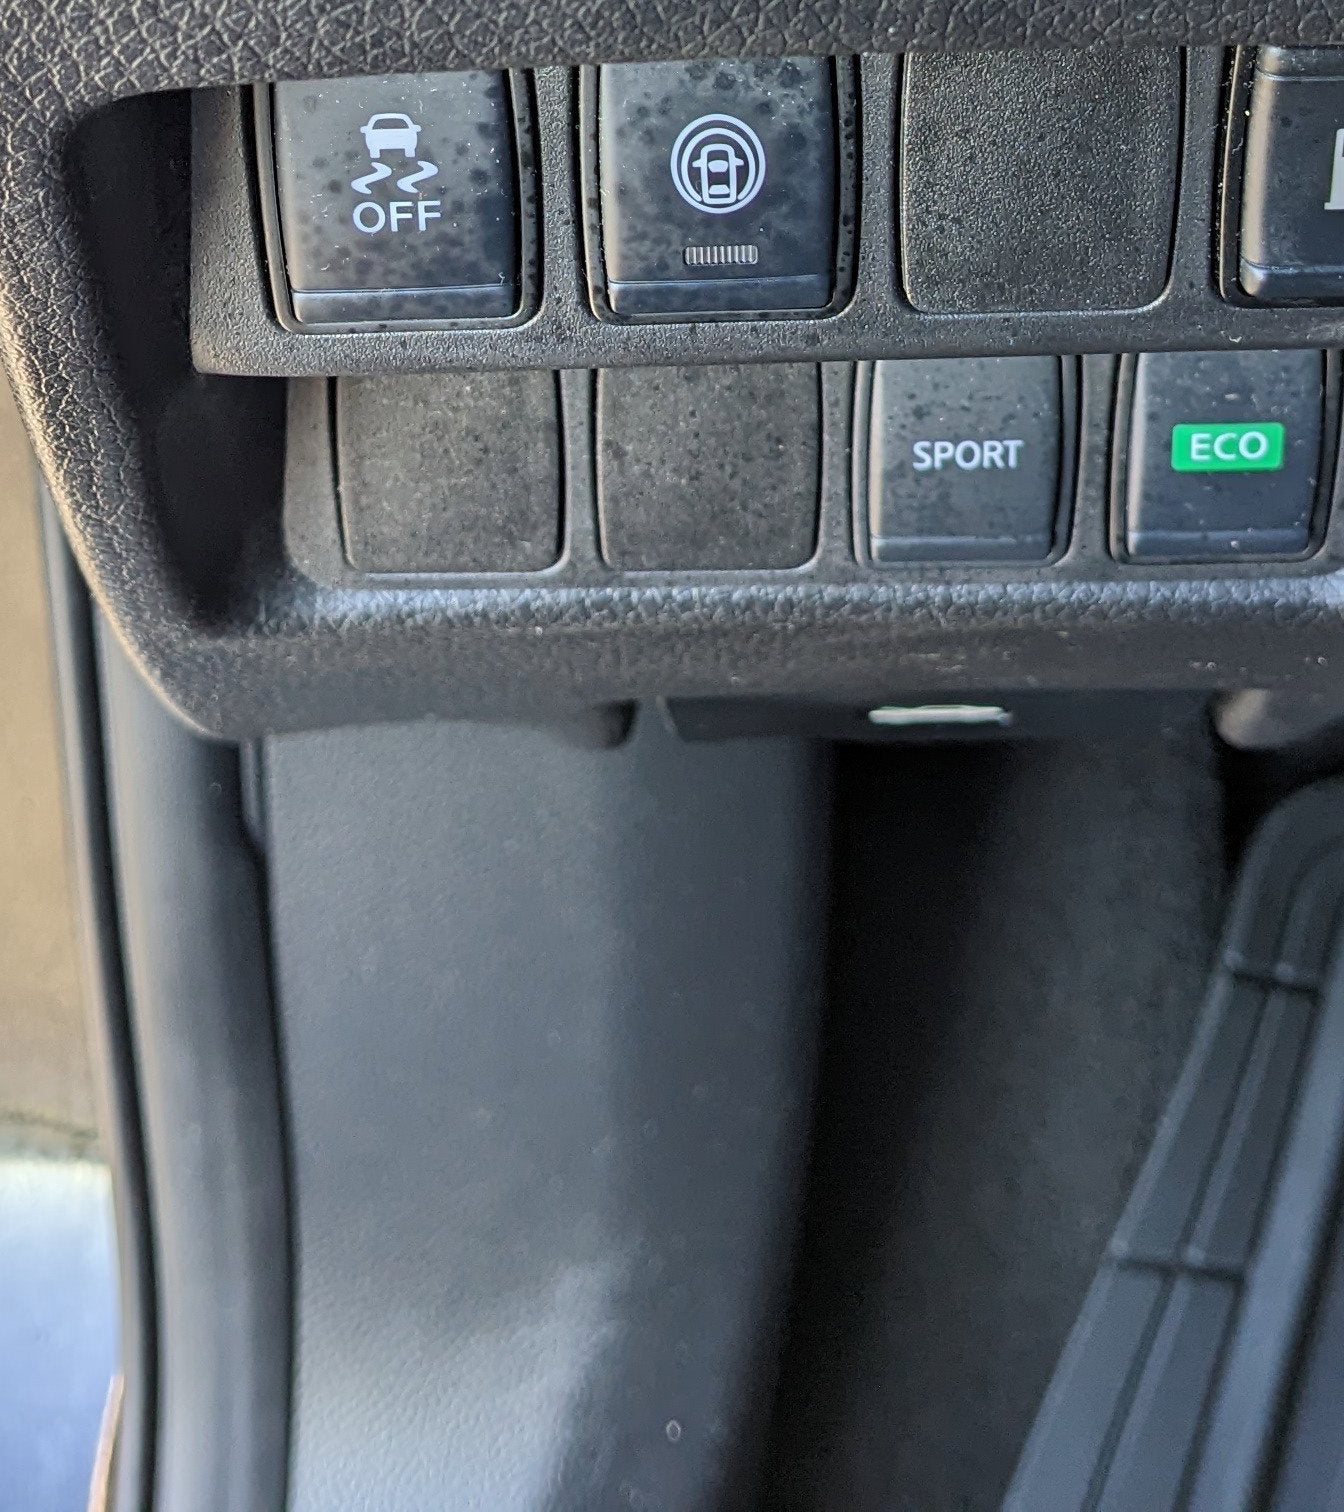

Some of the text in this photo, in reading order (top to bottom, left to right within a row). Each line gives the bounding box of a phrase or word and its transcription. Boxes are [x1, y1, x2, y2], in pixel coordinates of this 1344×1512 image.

[352, 200, 442, 233] OFF
[912, 440, 1026, 472] SPORT
[1190, 431, 1269, 462] ECO
